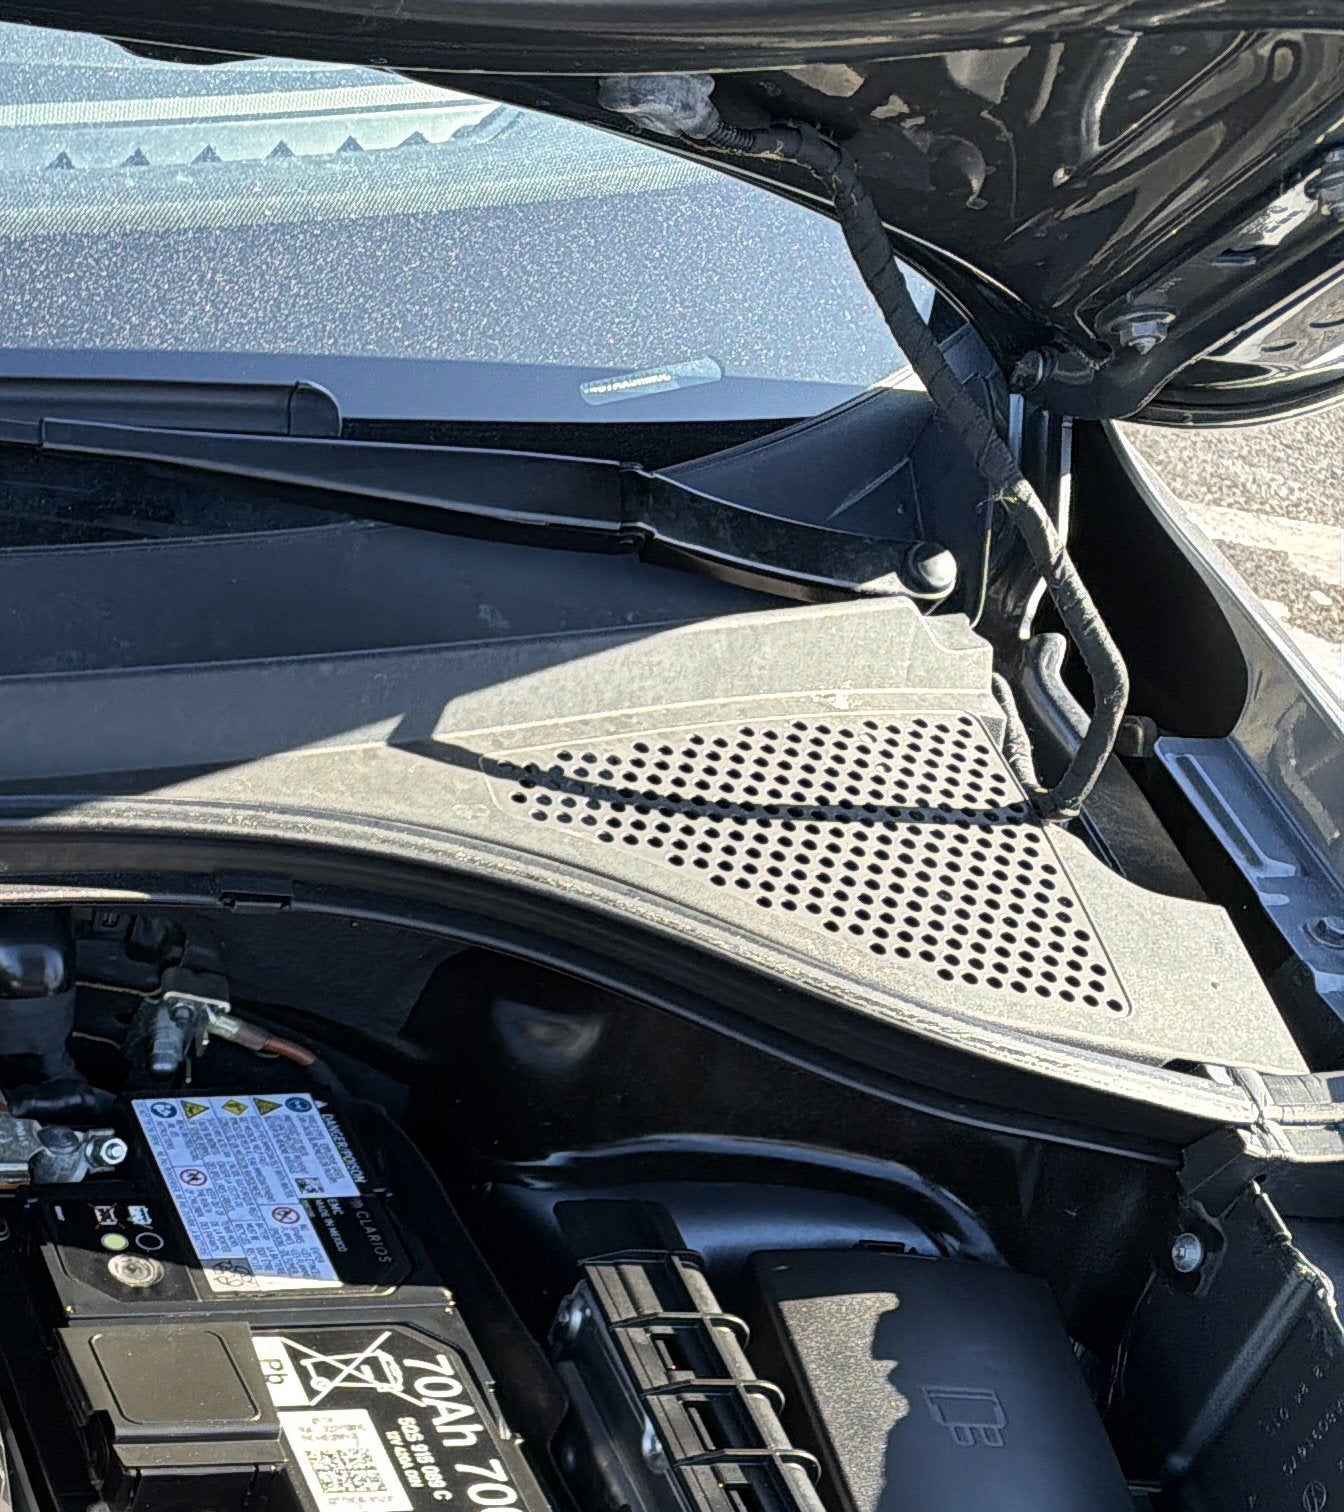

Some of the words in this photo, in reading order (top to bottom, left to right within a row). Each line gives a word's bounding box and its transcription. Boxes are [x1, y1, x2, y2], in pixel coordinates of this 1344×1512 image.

[323, 1113, 368, 1183] DANGER/POISON
[355, 1211, 393, 1263] CLARIOS
[401, 1354, 484, 1447] 70Ah
[433, 1489, 453, 1501] C
